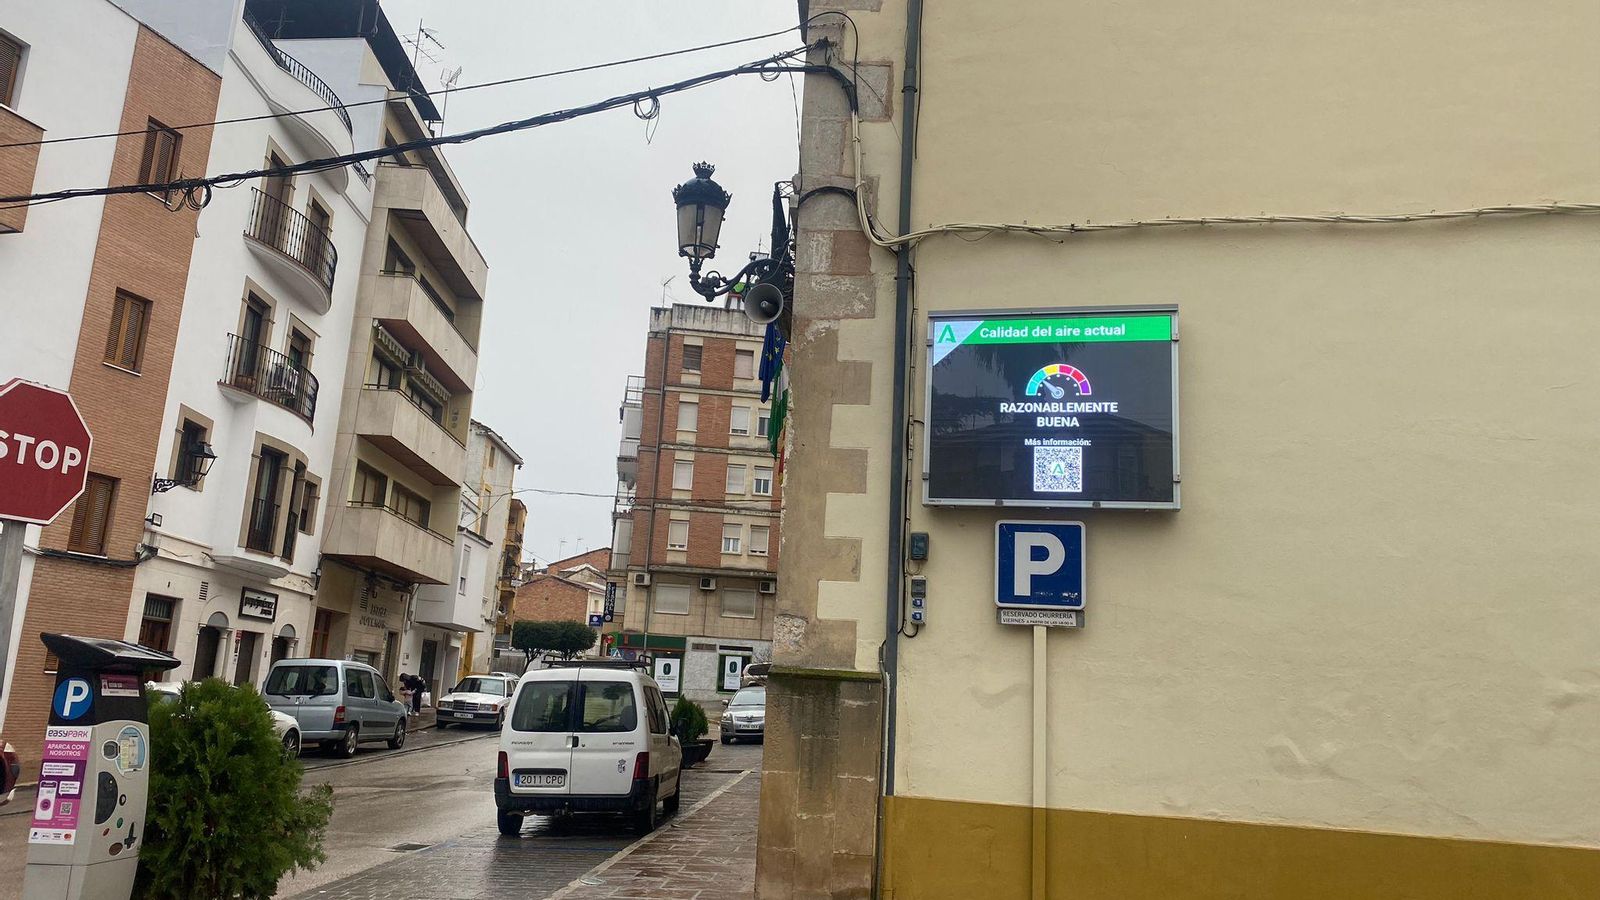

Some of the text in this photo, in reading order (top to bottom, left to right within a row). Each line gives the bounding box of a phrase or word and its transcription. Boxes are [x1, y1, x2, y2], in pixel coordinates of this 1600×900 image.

[980, 327, 1029, 339] Calidad
[1031, 325, 1052, 338] del
[1055, 325, 1080, 337] aire
[1084, 324, 1126, 336] actual
[1000, 402, 1119, 413] RAZONABLEMENTE
[1036, 417, 1080, 427] BUENA
[1024, 437, 1092, 447] Más información:
[1014, 531, 1066, 597] P
[1002, 610, 1038, 618] RESERVADO
[63, 680, 89, 716] P
[521, 775, 563, 785] 2011 CPC
